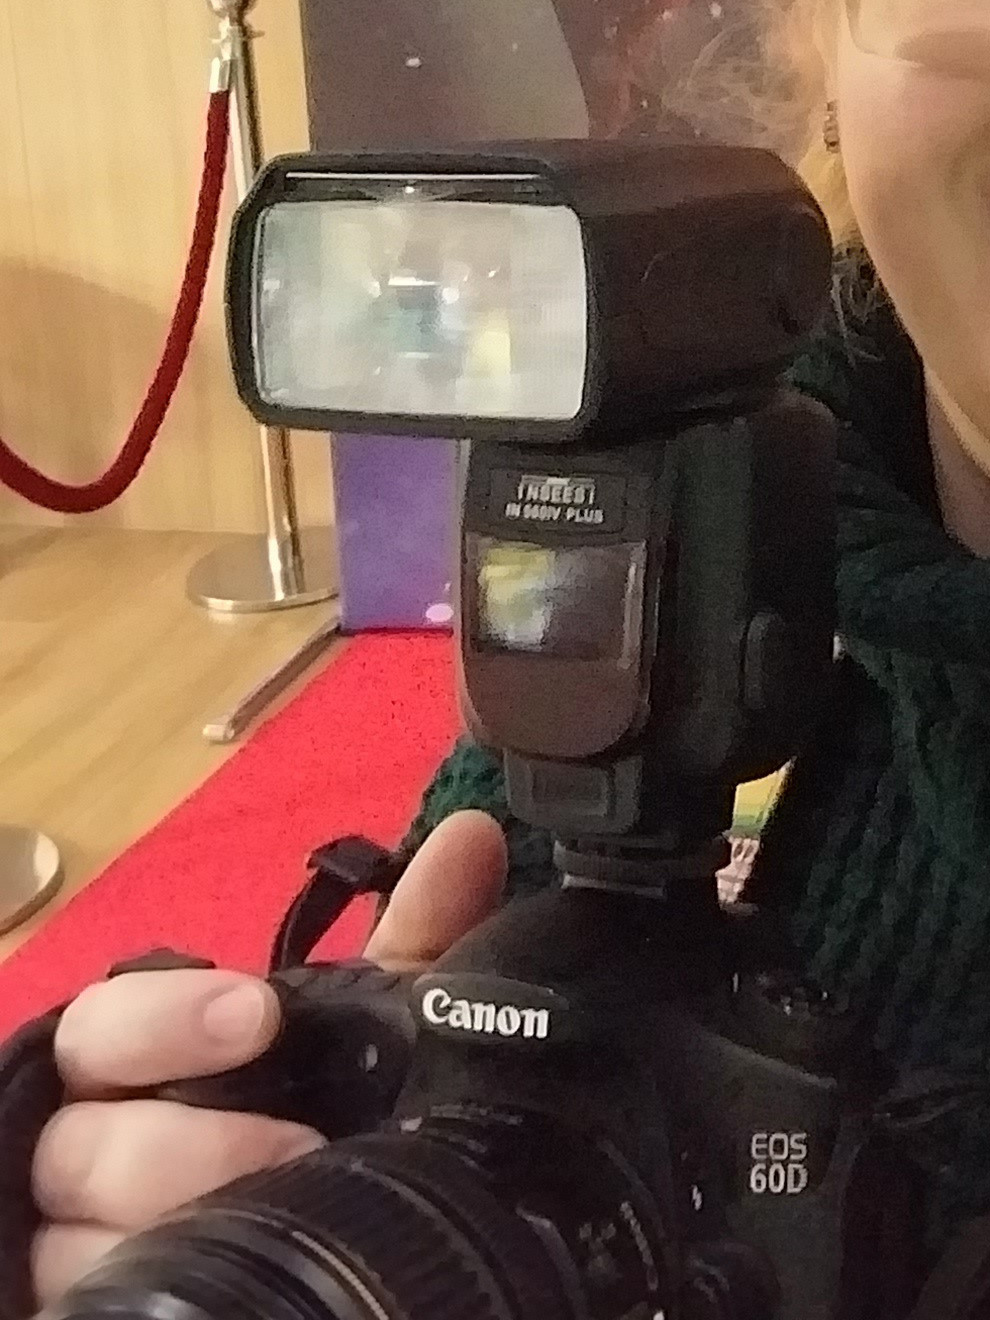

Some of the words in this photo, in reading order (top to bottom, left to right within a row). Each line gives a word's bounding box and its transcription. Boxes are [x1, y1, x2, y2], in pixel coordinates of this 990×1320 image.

[565, 506, 604, 524] PLUS
[421, 988, 550, 1038] Canon
[749, 1132, 808, 1161] EOS
[749, 1162, 809, 1194] 60D
